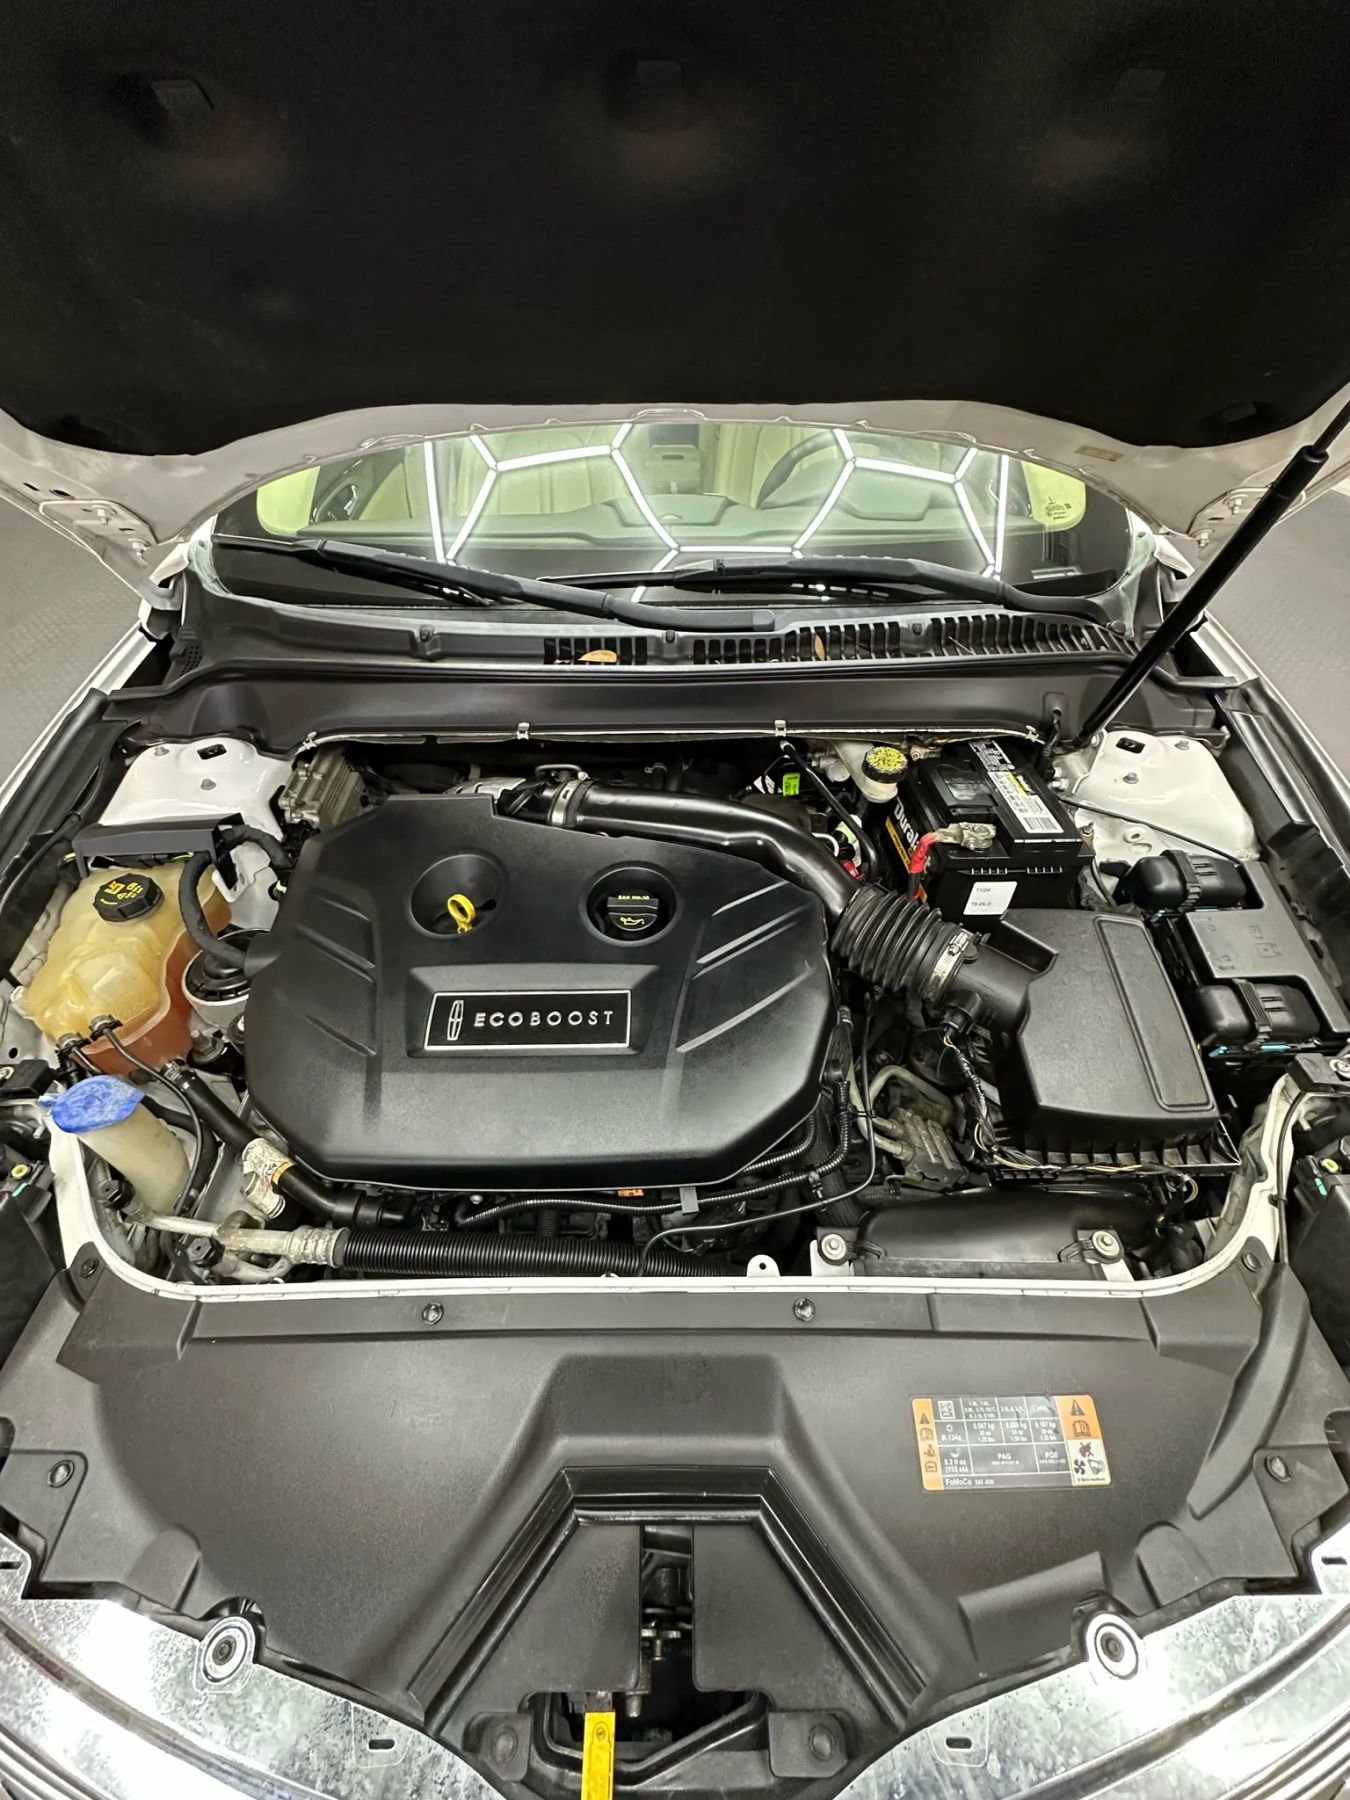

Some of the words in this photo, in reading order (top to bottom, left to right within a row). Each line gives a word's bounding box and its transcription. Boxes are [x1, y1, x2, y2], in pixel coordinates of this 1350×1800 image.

[474, 1010, 613, 1027] ECOBOOST
[997, 1452, 1012, 1460] PAG
[945, 1478, 973, 1486] FoMoCo
